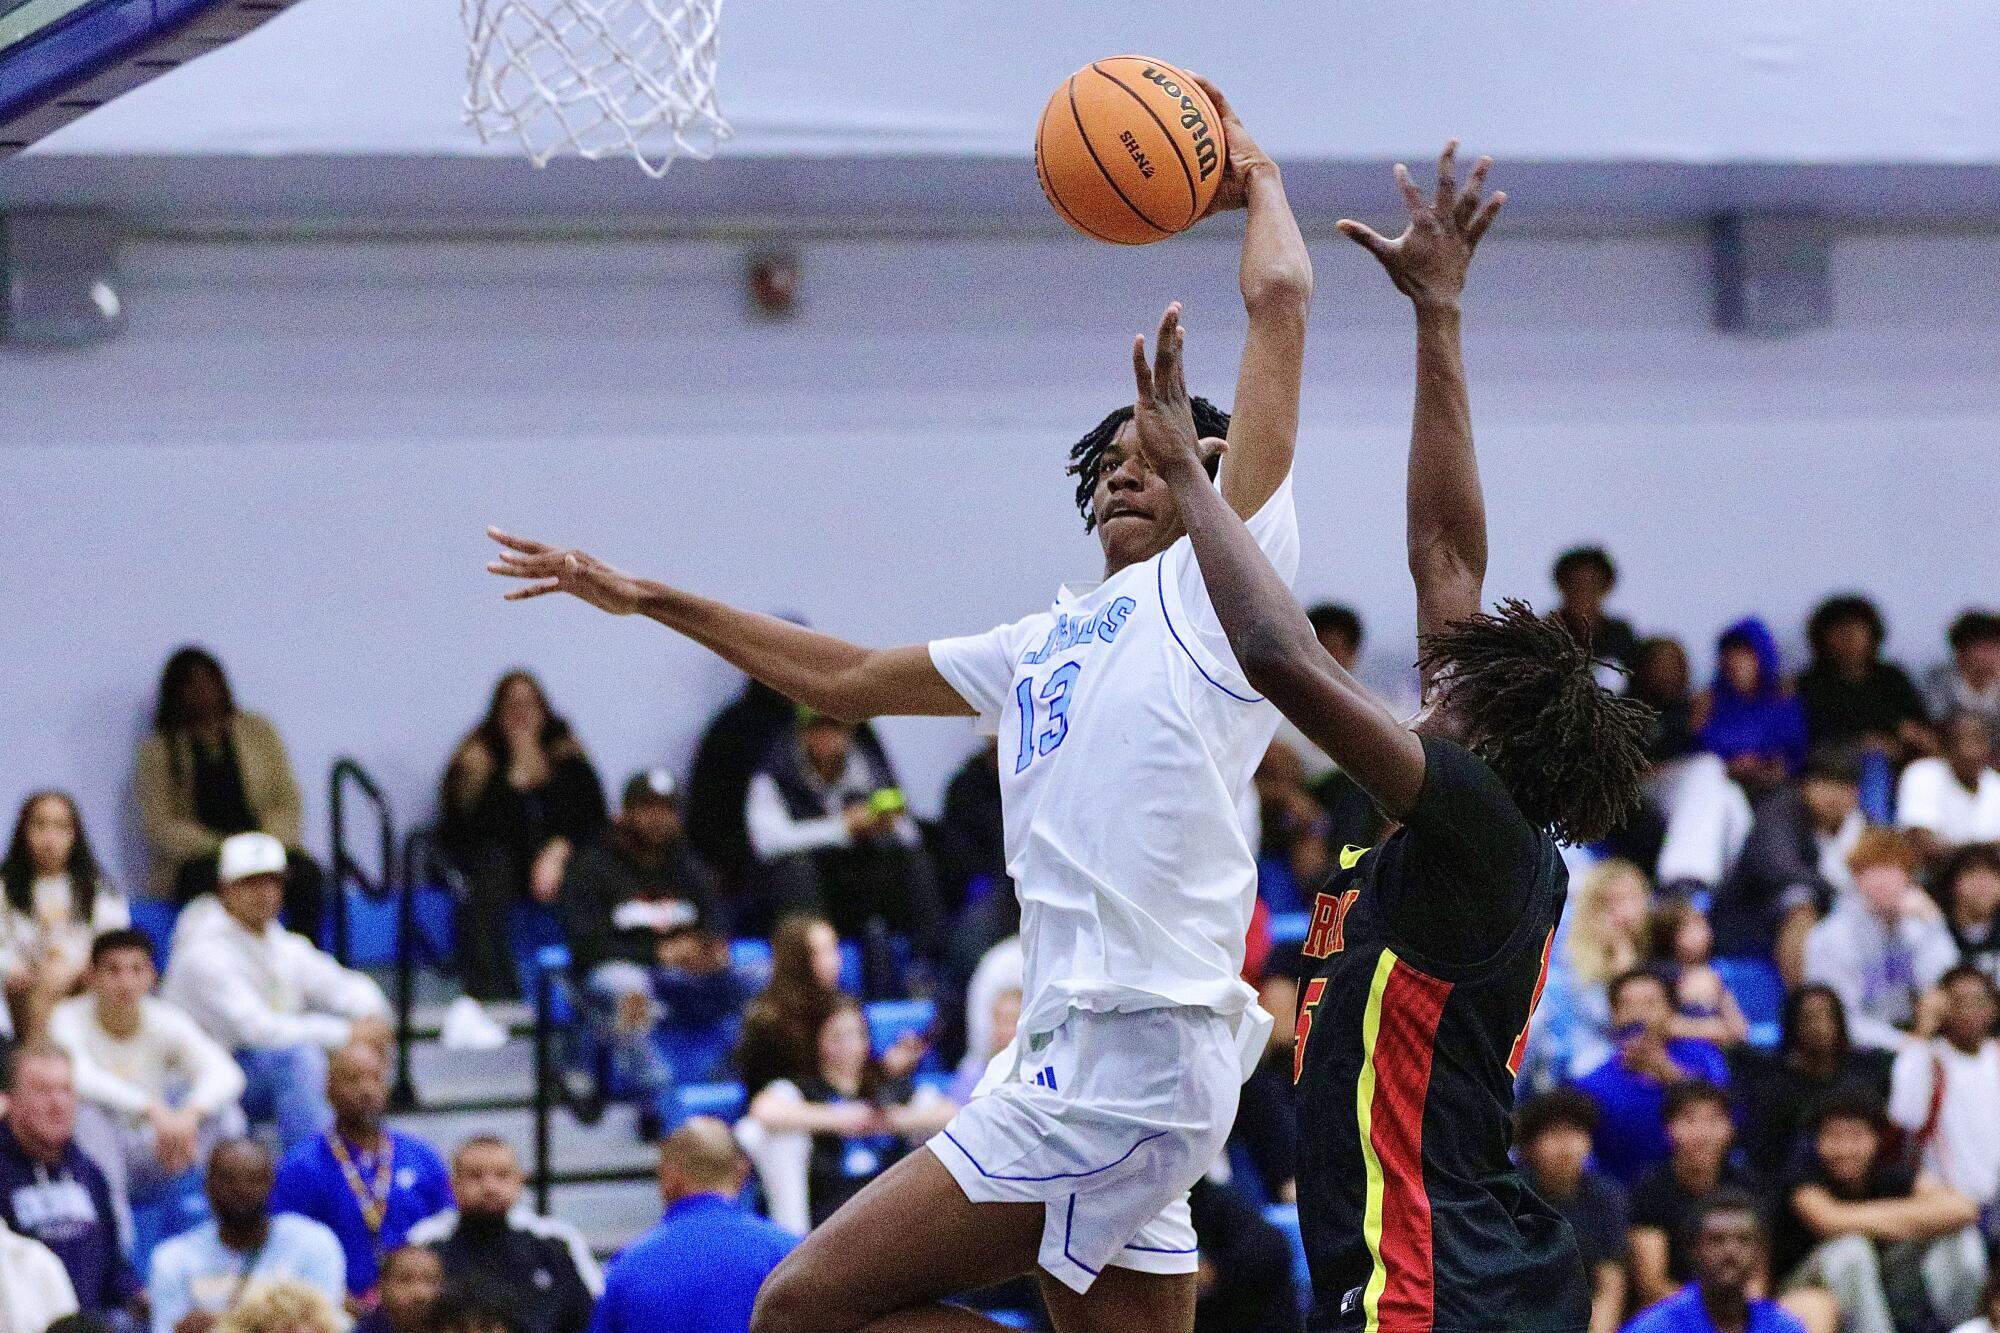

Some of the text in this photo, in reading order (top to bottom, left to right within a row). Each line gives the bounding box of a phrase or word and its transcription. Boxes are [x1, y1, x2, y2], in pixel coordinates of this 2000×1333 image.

[1120, 130, 1150, 170] NFHS
[1142, 66, 1219, 183] Wilson
[1015, 660, 1082, 775] 13
